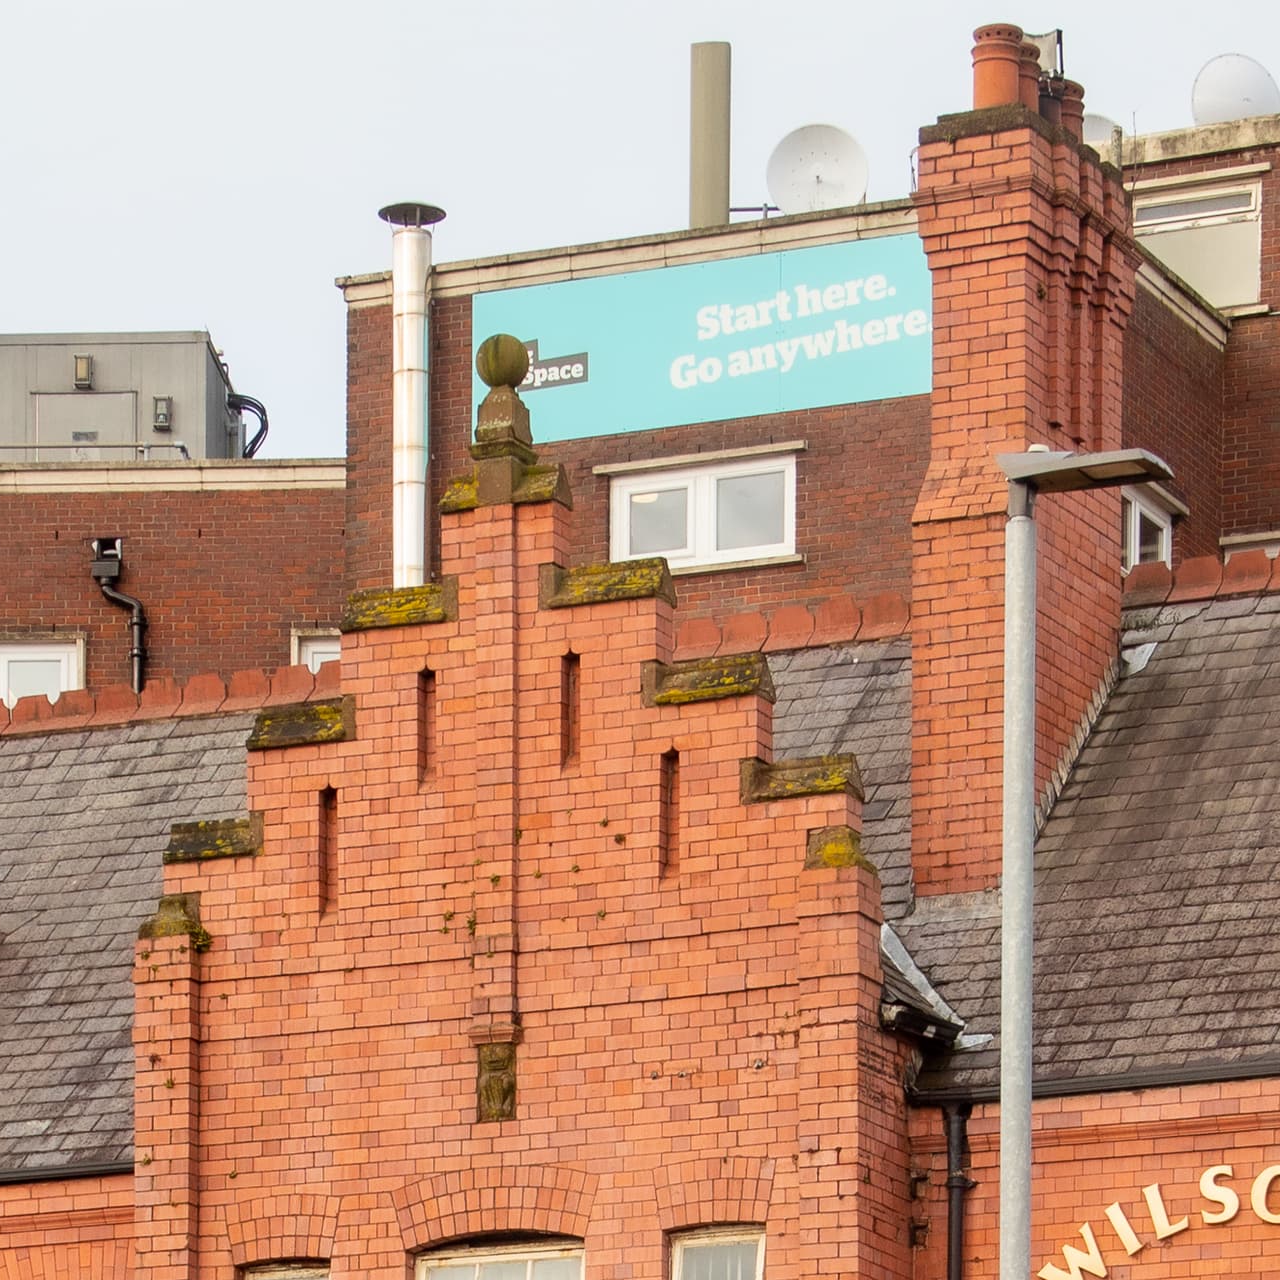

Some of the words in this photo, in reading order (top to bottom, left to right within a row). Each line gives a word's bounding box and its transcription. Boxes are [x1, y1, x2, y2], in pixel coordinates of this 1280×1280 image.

[696, 290, 792, 341] Start
[794, 274, 896, 317] here.
[670, 354, 723, 389] Go
